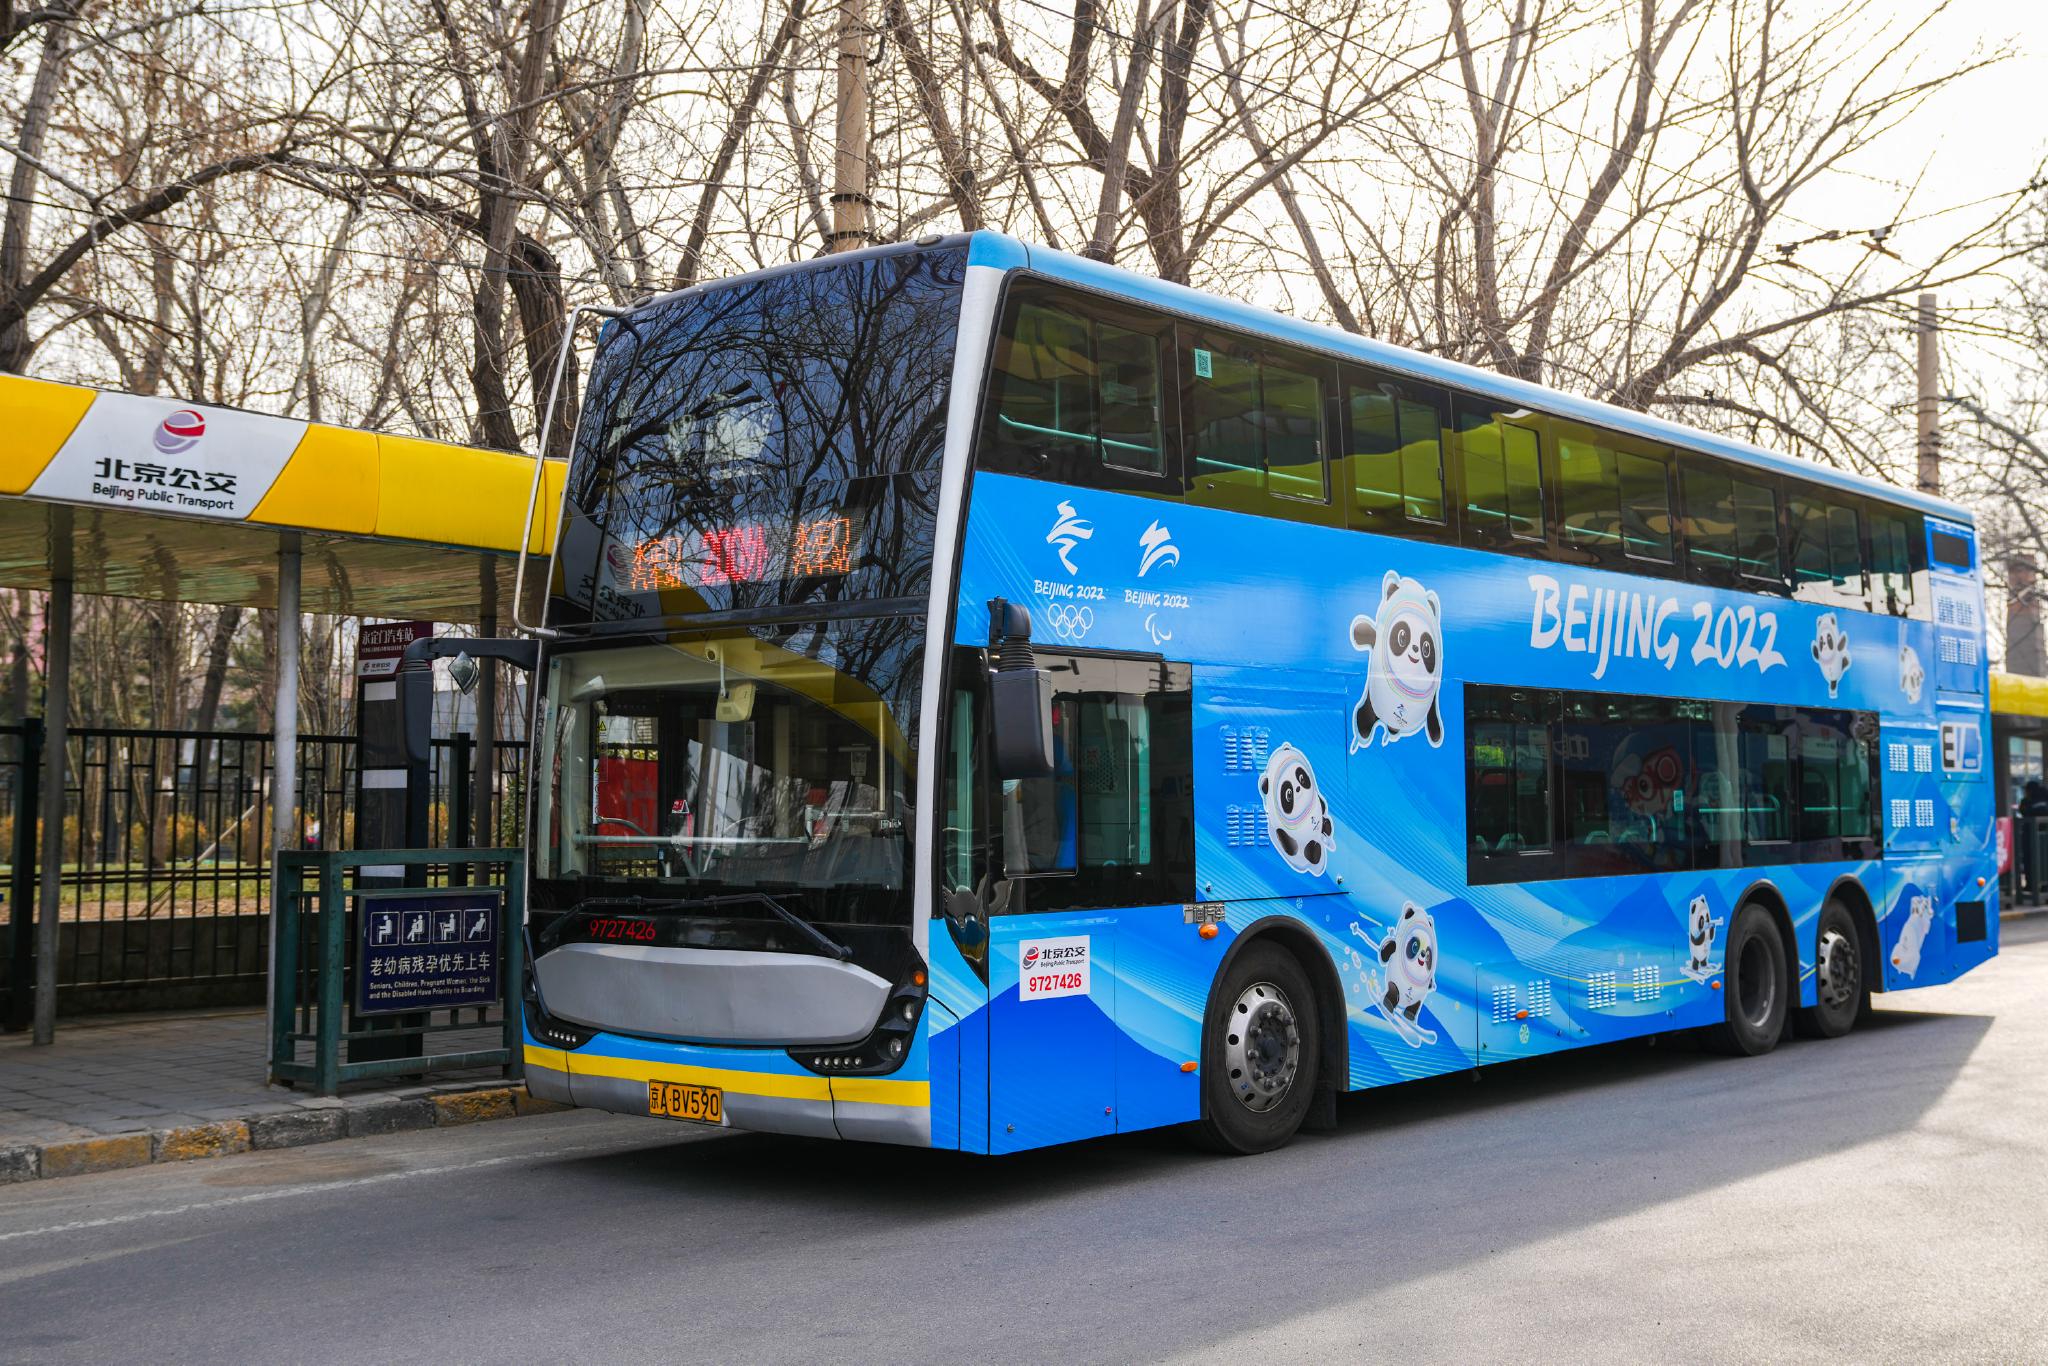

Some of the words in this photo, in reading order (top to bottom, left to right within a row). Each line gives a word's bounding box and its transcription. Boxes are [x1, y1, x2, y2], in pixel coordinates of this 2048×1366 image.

[94, 457, 237, 495] 北京公交
[93, 483, 134, 500] Beijing
[138, 488, 173, 503] Public
[177, 493, 234, 510] Transport
[1034, 579, 1074, 600] BEIJING
[1077, 585, 1106, 600] 2022
[1125, 589, 1161, 608] BEIJING
[1163, 594, 1191, 609] 2022
[362, 627, 415, 645] 永定门汽车站
[1528, 574, 1680, 681] BEIJING
[1691, 601, 1788, 674] 2022
[589, 919, 657, 940] 9727426
[1042, 946, 1086, 960] 北京公交
[370, 951, 490, 976] 老幼病残孕优先上车
[370, 982, 393, 990] Seniors,
[394, 980, 419, 989] Children,
[420, 979, 445, 988] Pregnant
[479, 976, 491, 984] Sick
[381, 990, 391, 998] the
[392, 988, 417, 997] Disabled
[418, 988, 431, 996] Have
[432, 987, 452, 996] Priority
[1029, 973, 1082, 992] 9727426
